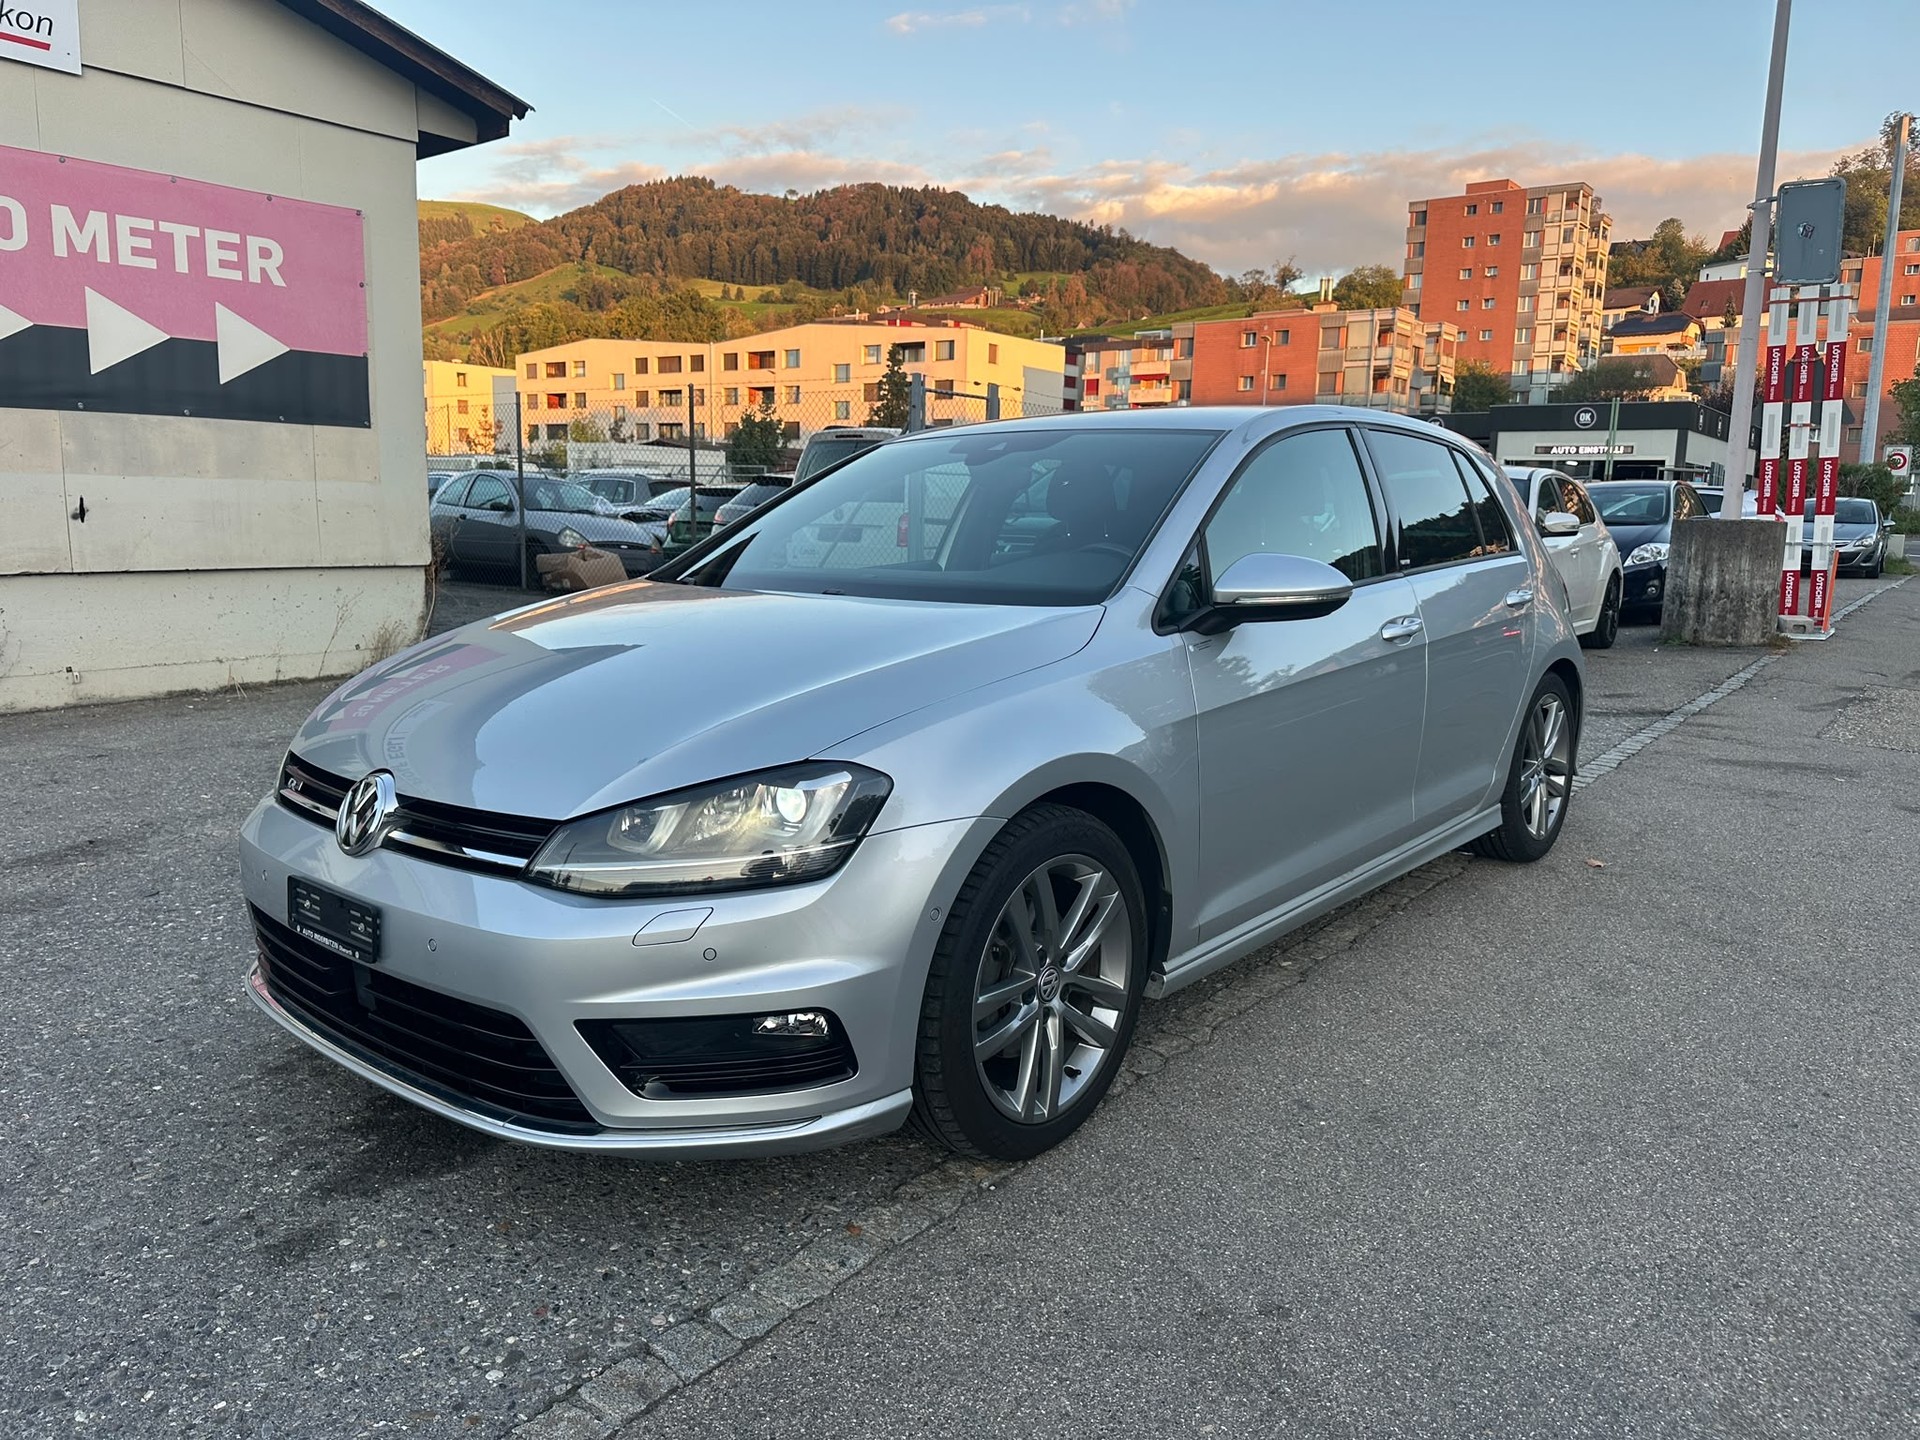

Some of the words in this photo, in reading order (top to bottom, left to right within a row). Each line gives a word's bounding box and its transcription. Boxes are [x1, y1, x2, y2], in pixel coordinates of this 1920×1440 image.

[50, 203, 287, 287] METER
[1579, 412, 1592, 422] OK
[1551, 446, 1577, 455] AUTO
[302, 927, 314, 938] AUTO
